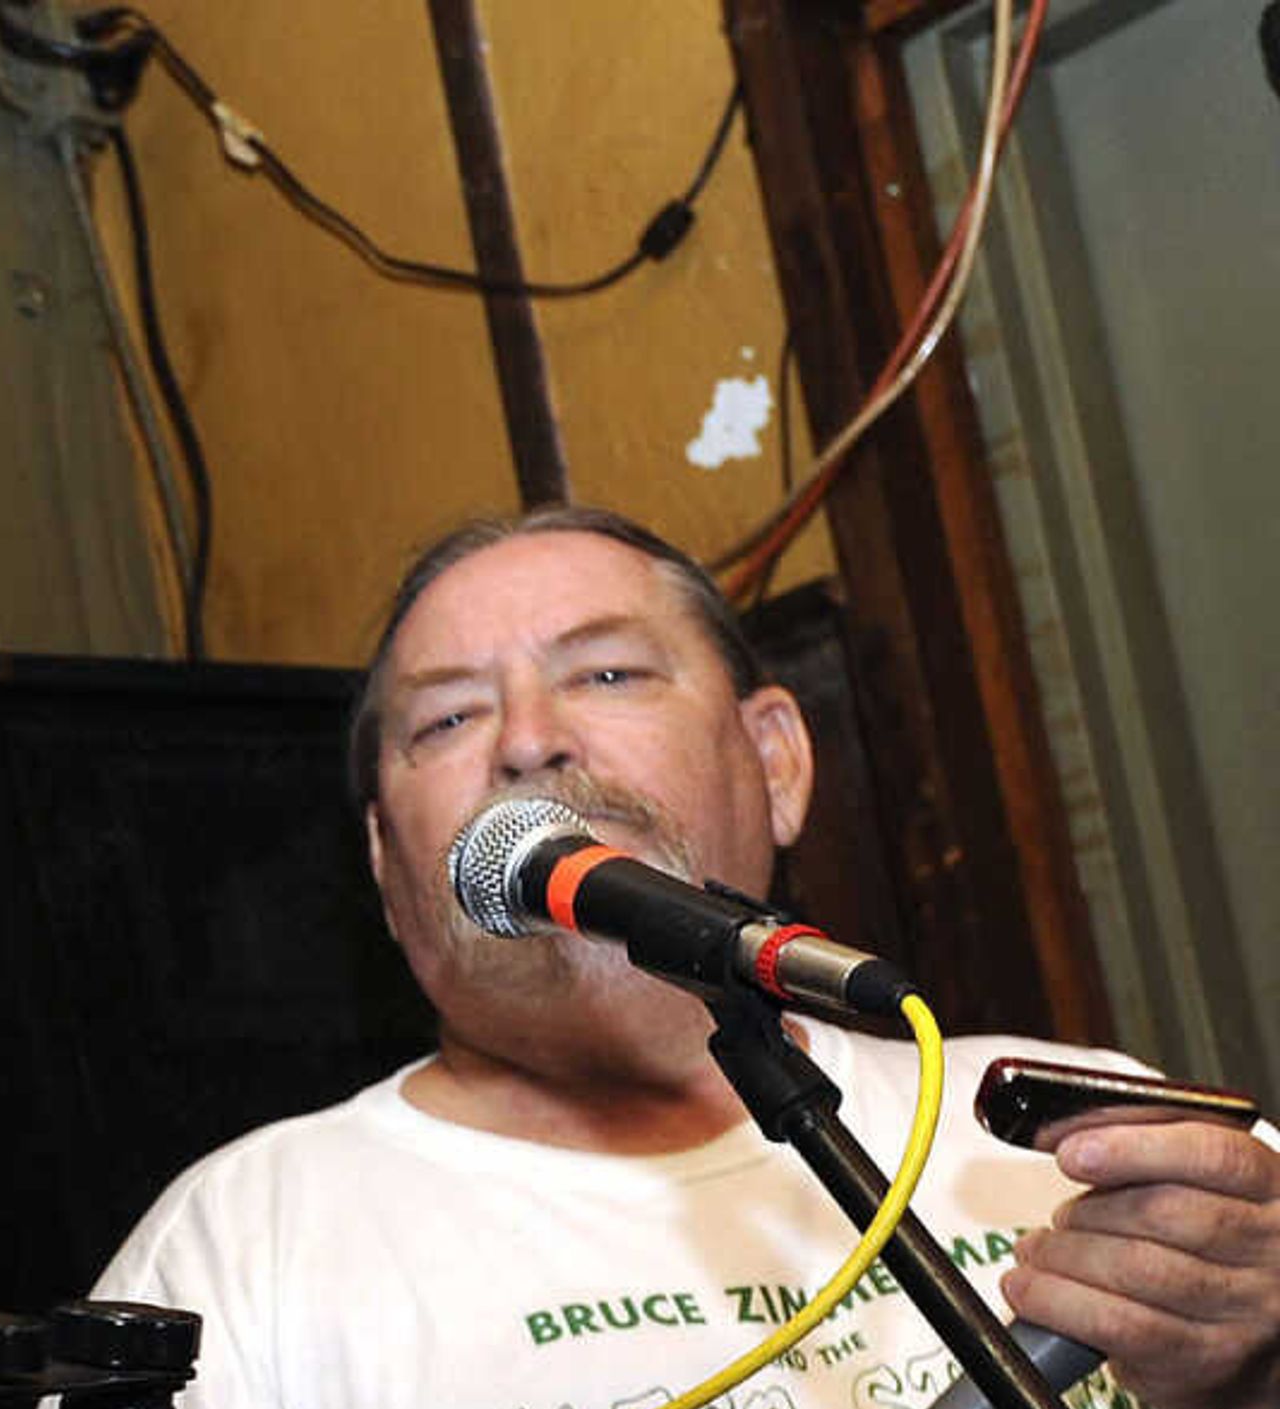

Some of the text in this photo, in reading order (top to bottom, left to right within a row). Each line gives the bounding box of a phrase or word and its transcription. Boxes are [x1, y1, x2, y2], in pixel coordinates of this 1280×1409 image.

[525, 1293, 707, 1345] BRUCE
[778, 1331, 867, 1372] ND THE
